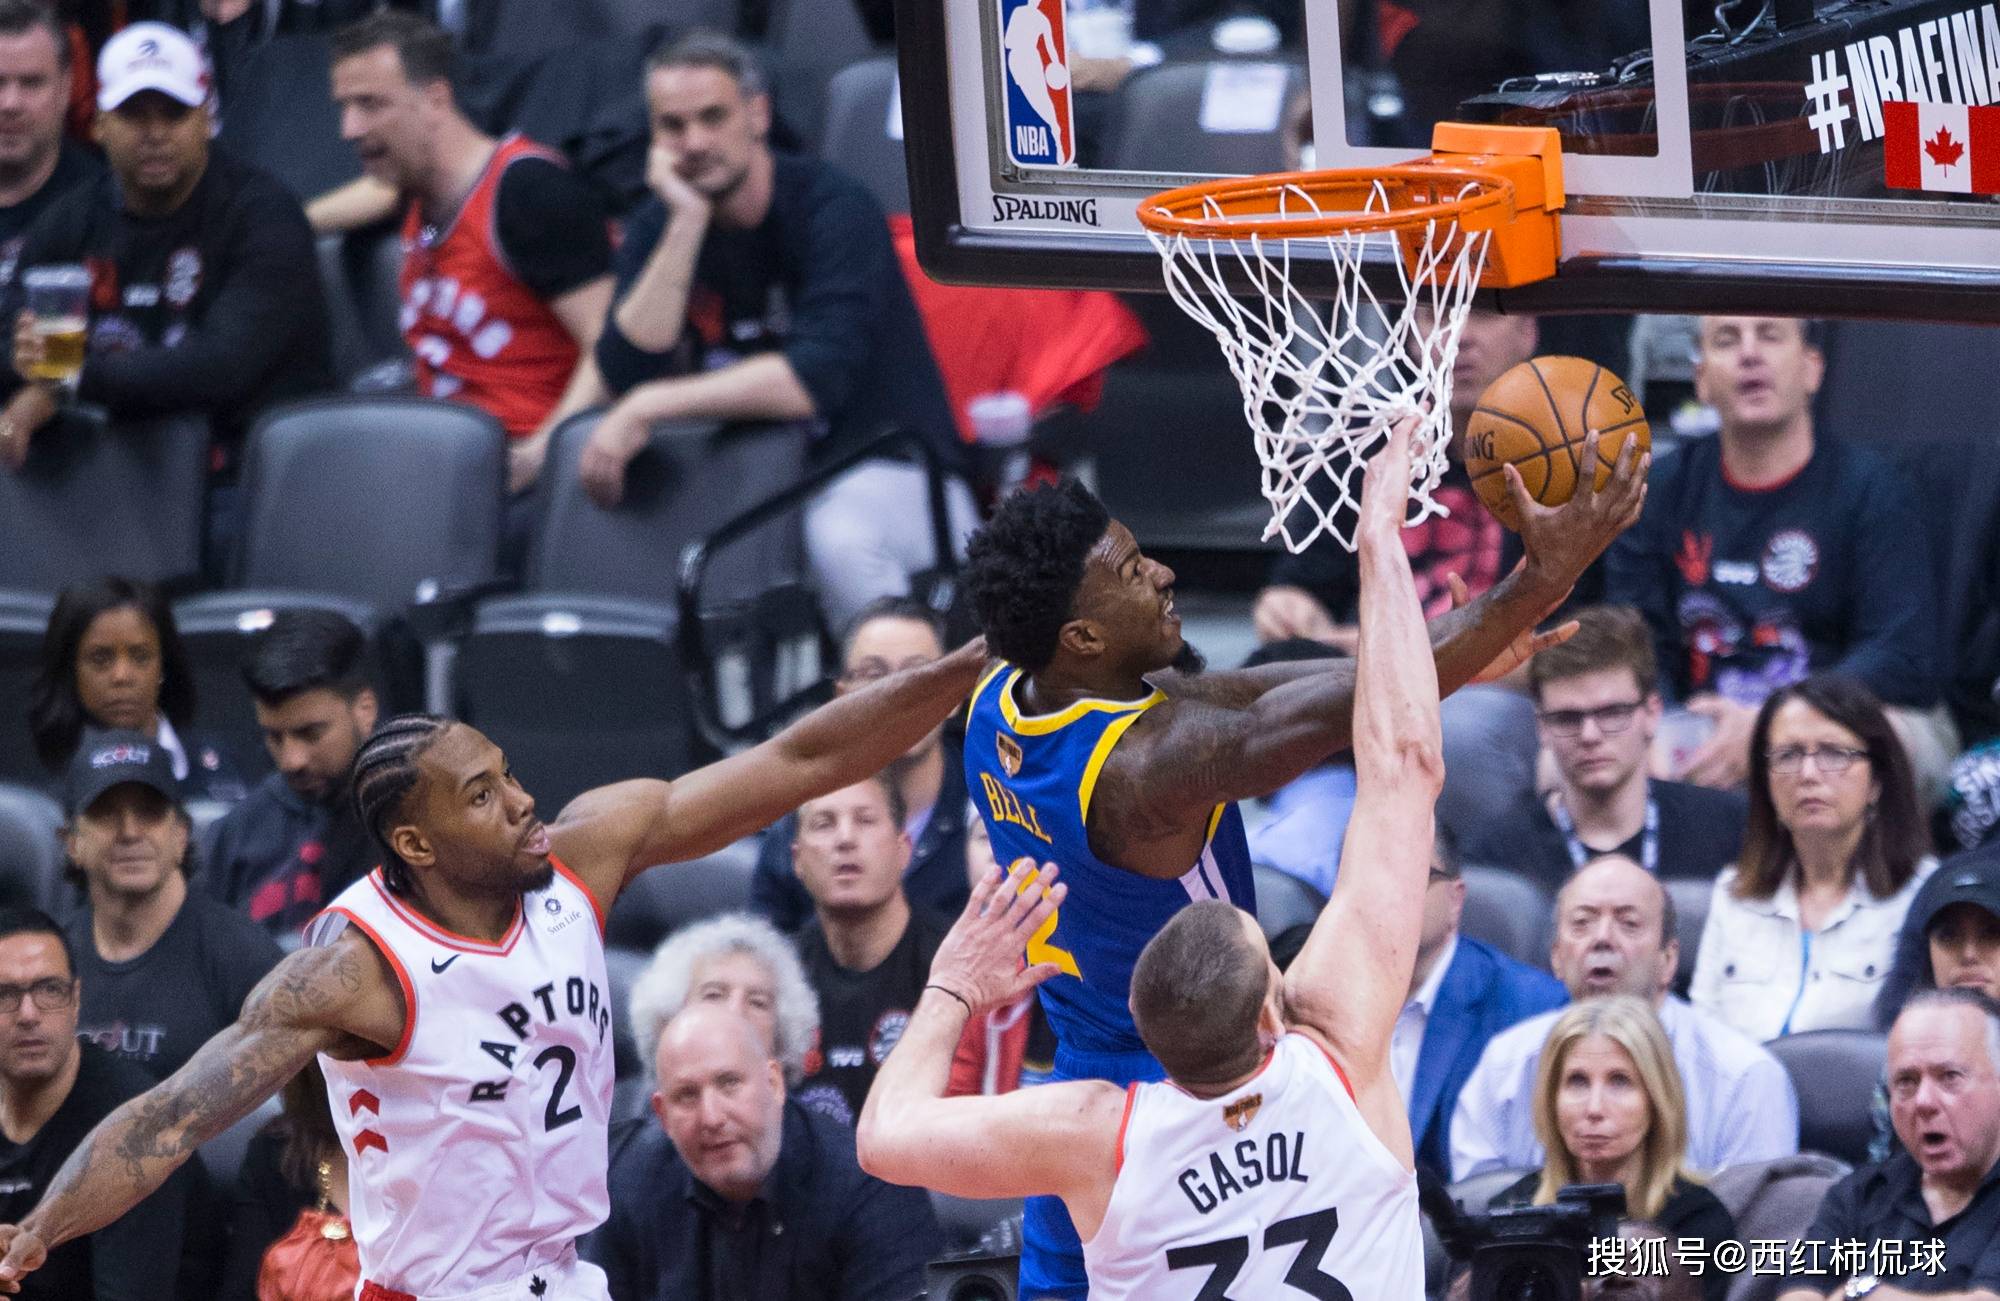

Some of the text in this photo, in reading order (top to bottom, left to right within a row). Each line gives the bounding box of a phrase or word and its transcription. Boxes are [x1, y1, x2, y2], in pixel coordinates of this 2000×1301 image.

[1016, 125, 1050, 156] NBA
[993, 195, 1100, 226] SPALDING
[980, 772, 1053, 844] BELL
[547, 911, 583, 936] Sun Life
[469, 976, 609, 1102] RAPTORS
[533, 1045, 583, 1133] 2
[1178, 1131, 1309, 1215] GASOL
